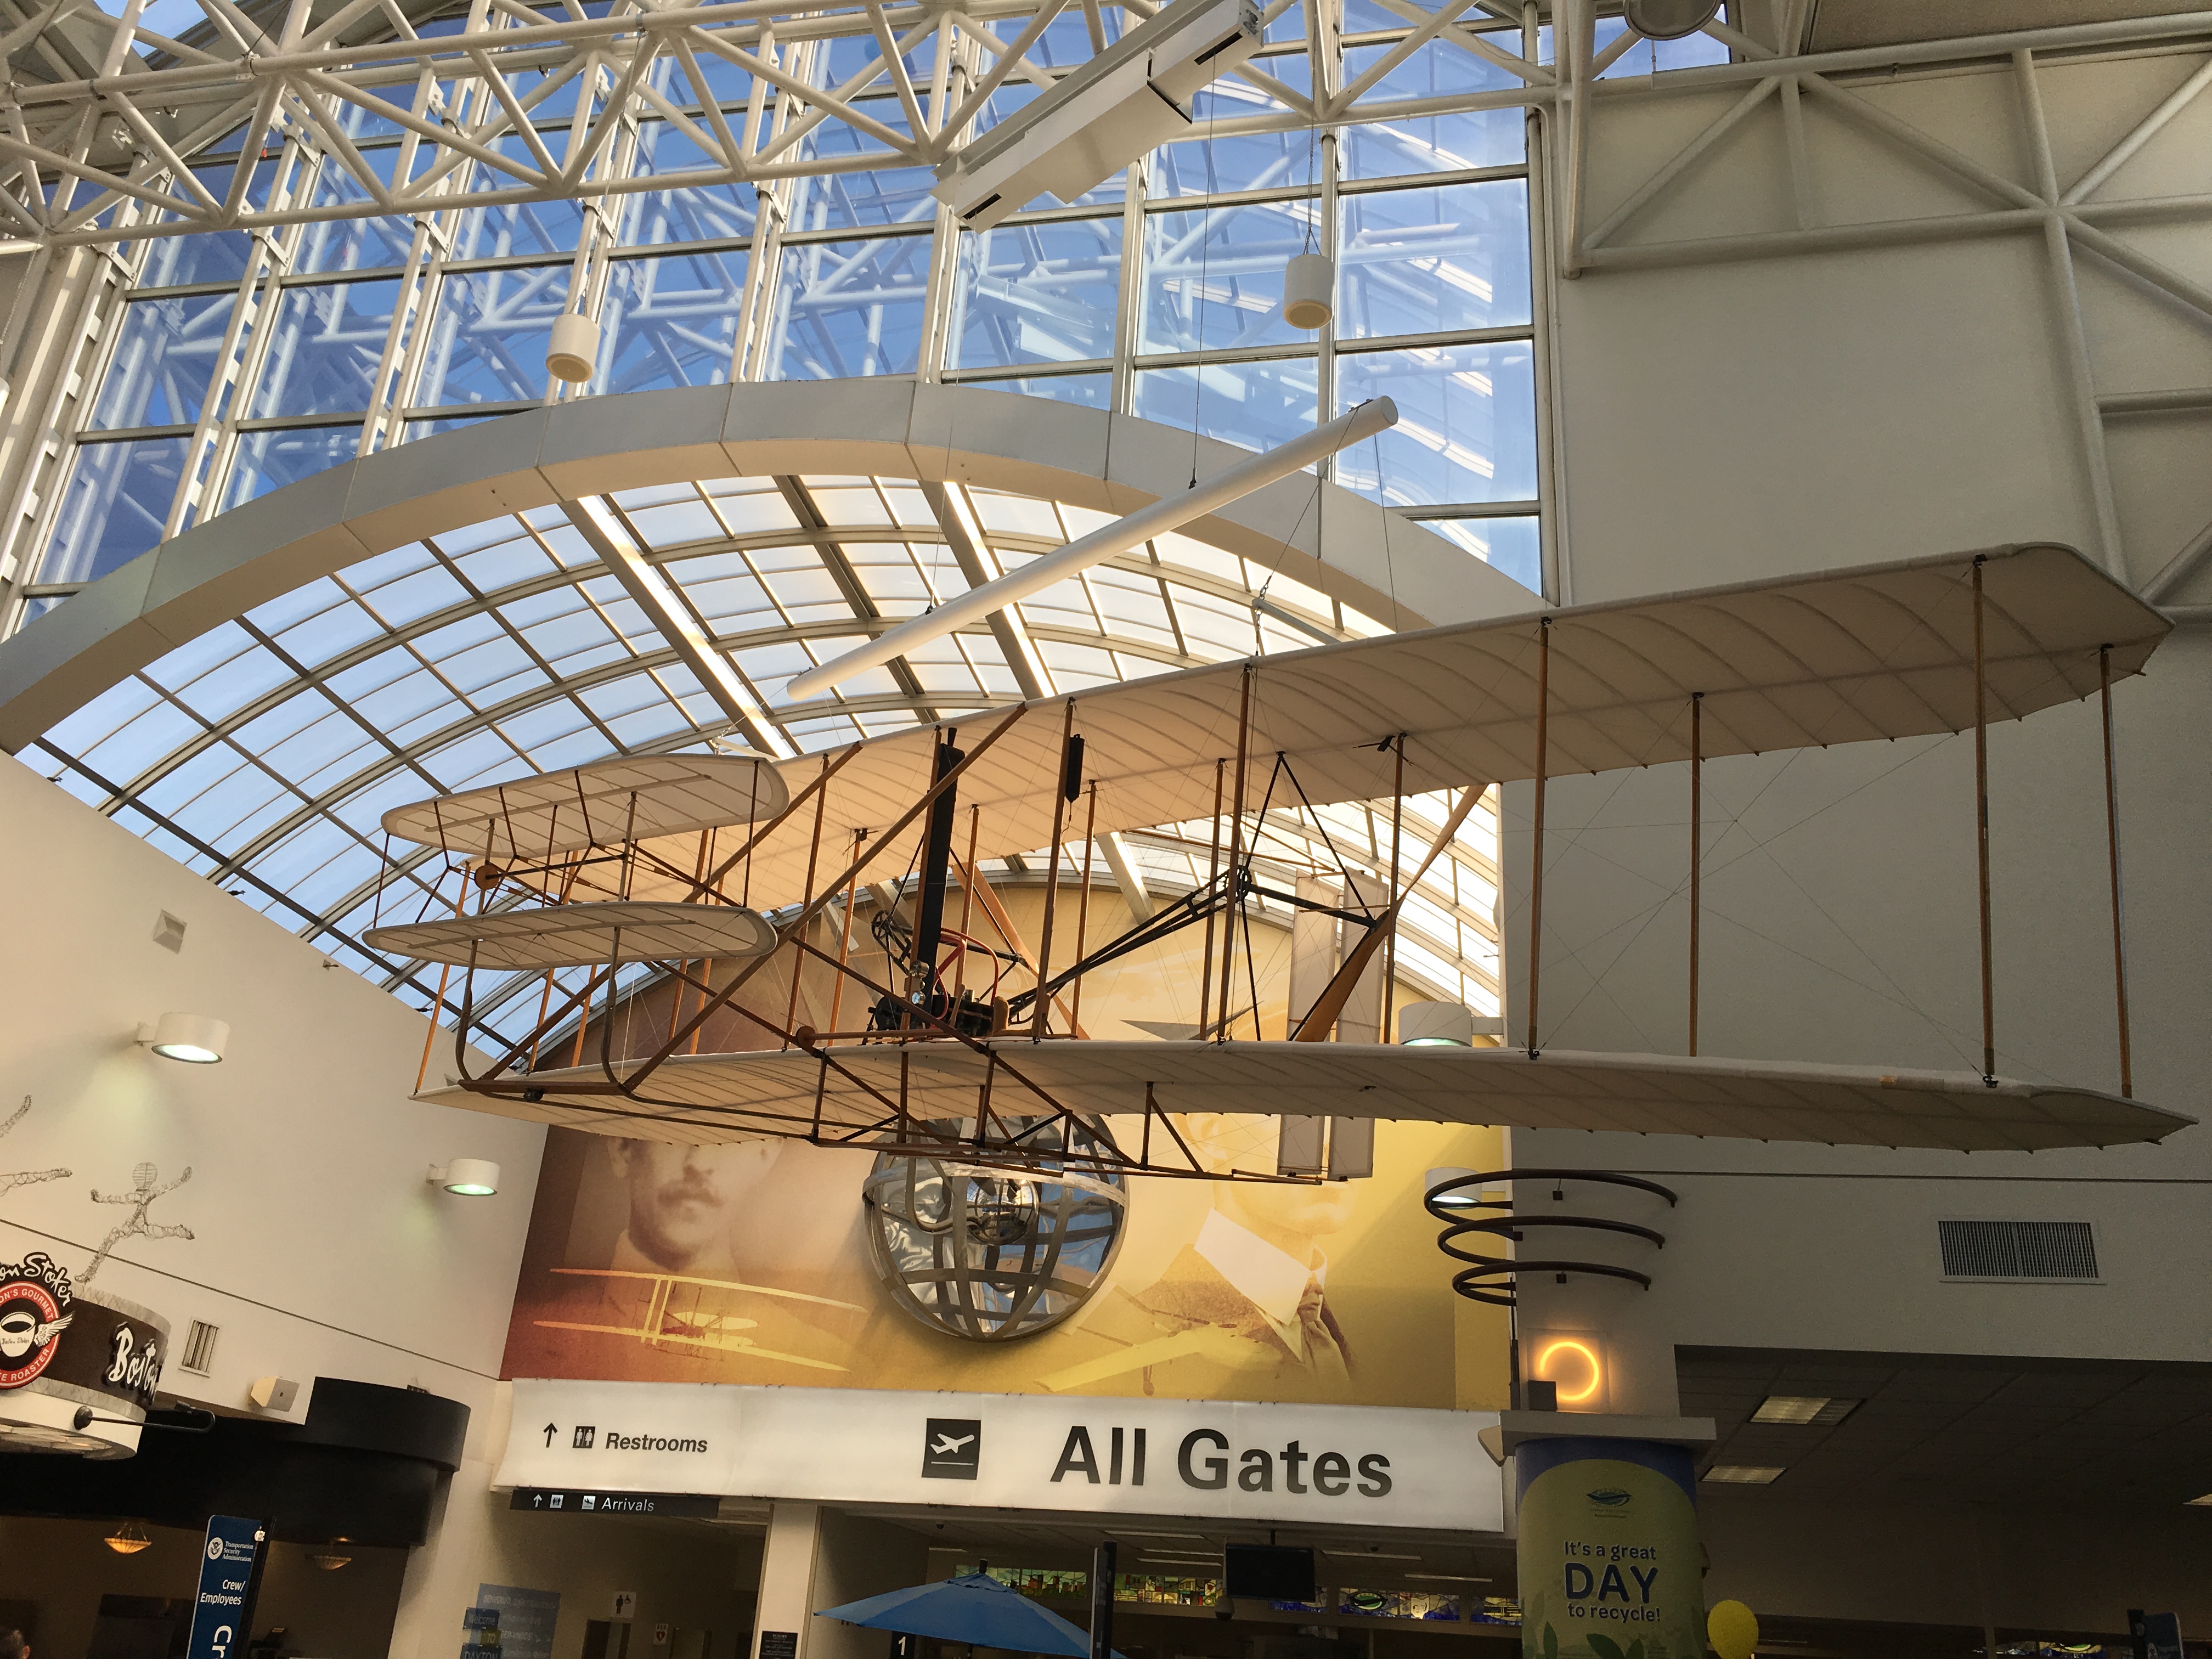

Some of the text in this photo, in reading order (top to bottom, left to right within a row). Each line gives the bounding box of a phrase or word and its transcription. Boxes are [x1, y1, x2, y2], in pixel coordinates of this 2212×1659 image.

[24, 1254, 71, 1307] Stoker
[21, 1288, 54, 1319] GOURMET
[10, 1348, 50, 1381] ROASTER
[605, 1432, 708, 1453] Restrooms
[1050, 1425, 1392, 1498] All Gates
[601, 1497, 654, 1512] Arrivals
[223, 1547, 241, 1556] Security
[225, 1541, 254, 1549] Transportation
[1565, 1542, 1657, 1561] It's a great
[222, 1554, 252, 1562] Administration
[222, 1579, 246, 1592] Crew/
[1565, 1562, 1658, 1604] DAY
[200, 1592, 242, 1606] Employees
[1567, 1603, 1661, 1624] to recycle!
[211, 1625, 233, 1659] Cr
[487, 1633, 496, 1643] TO
[898, 1636, 906, 1656] 1
